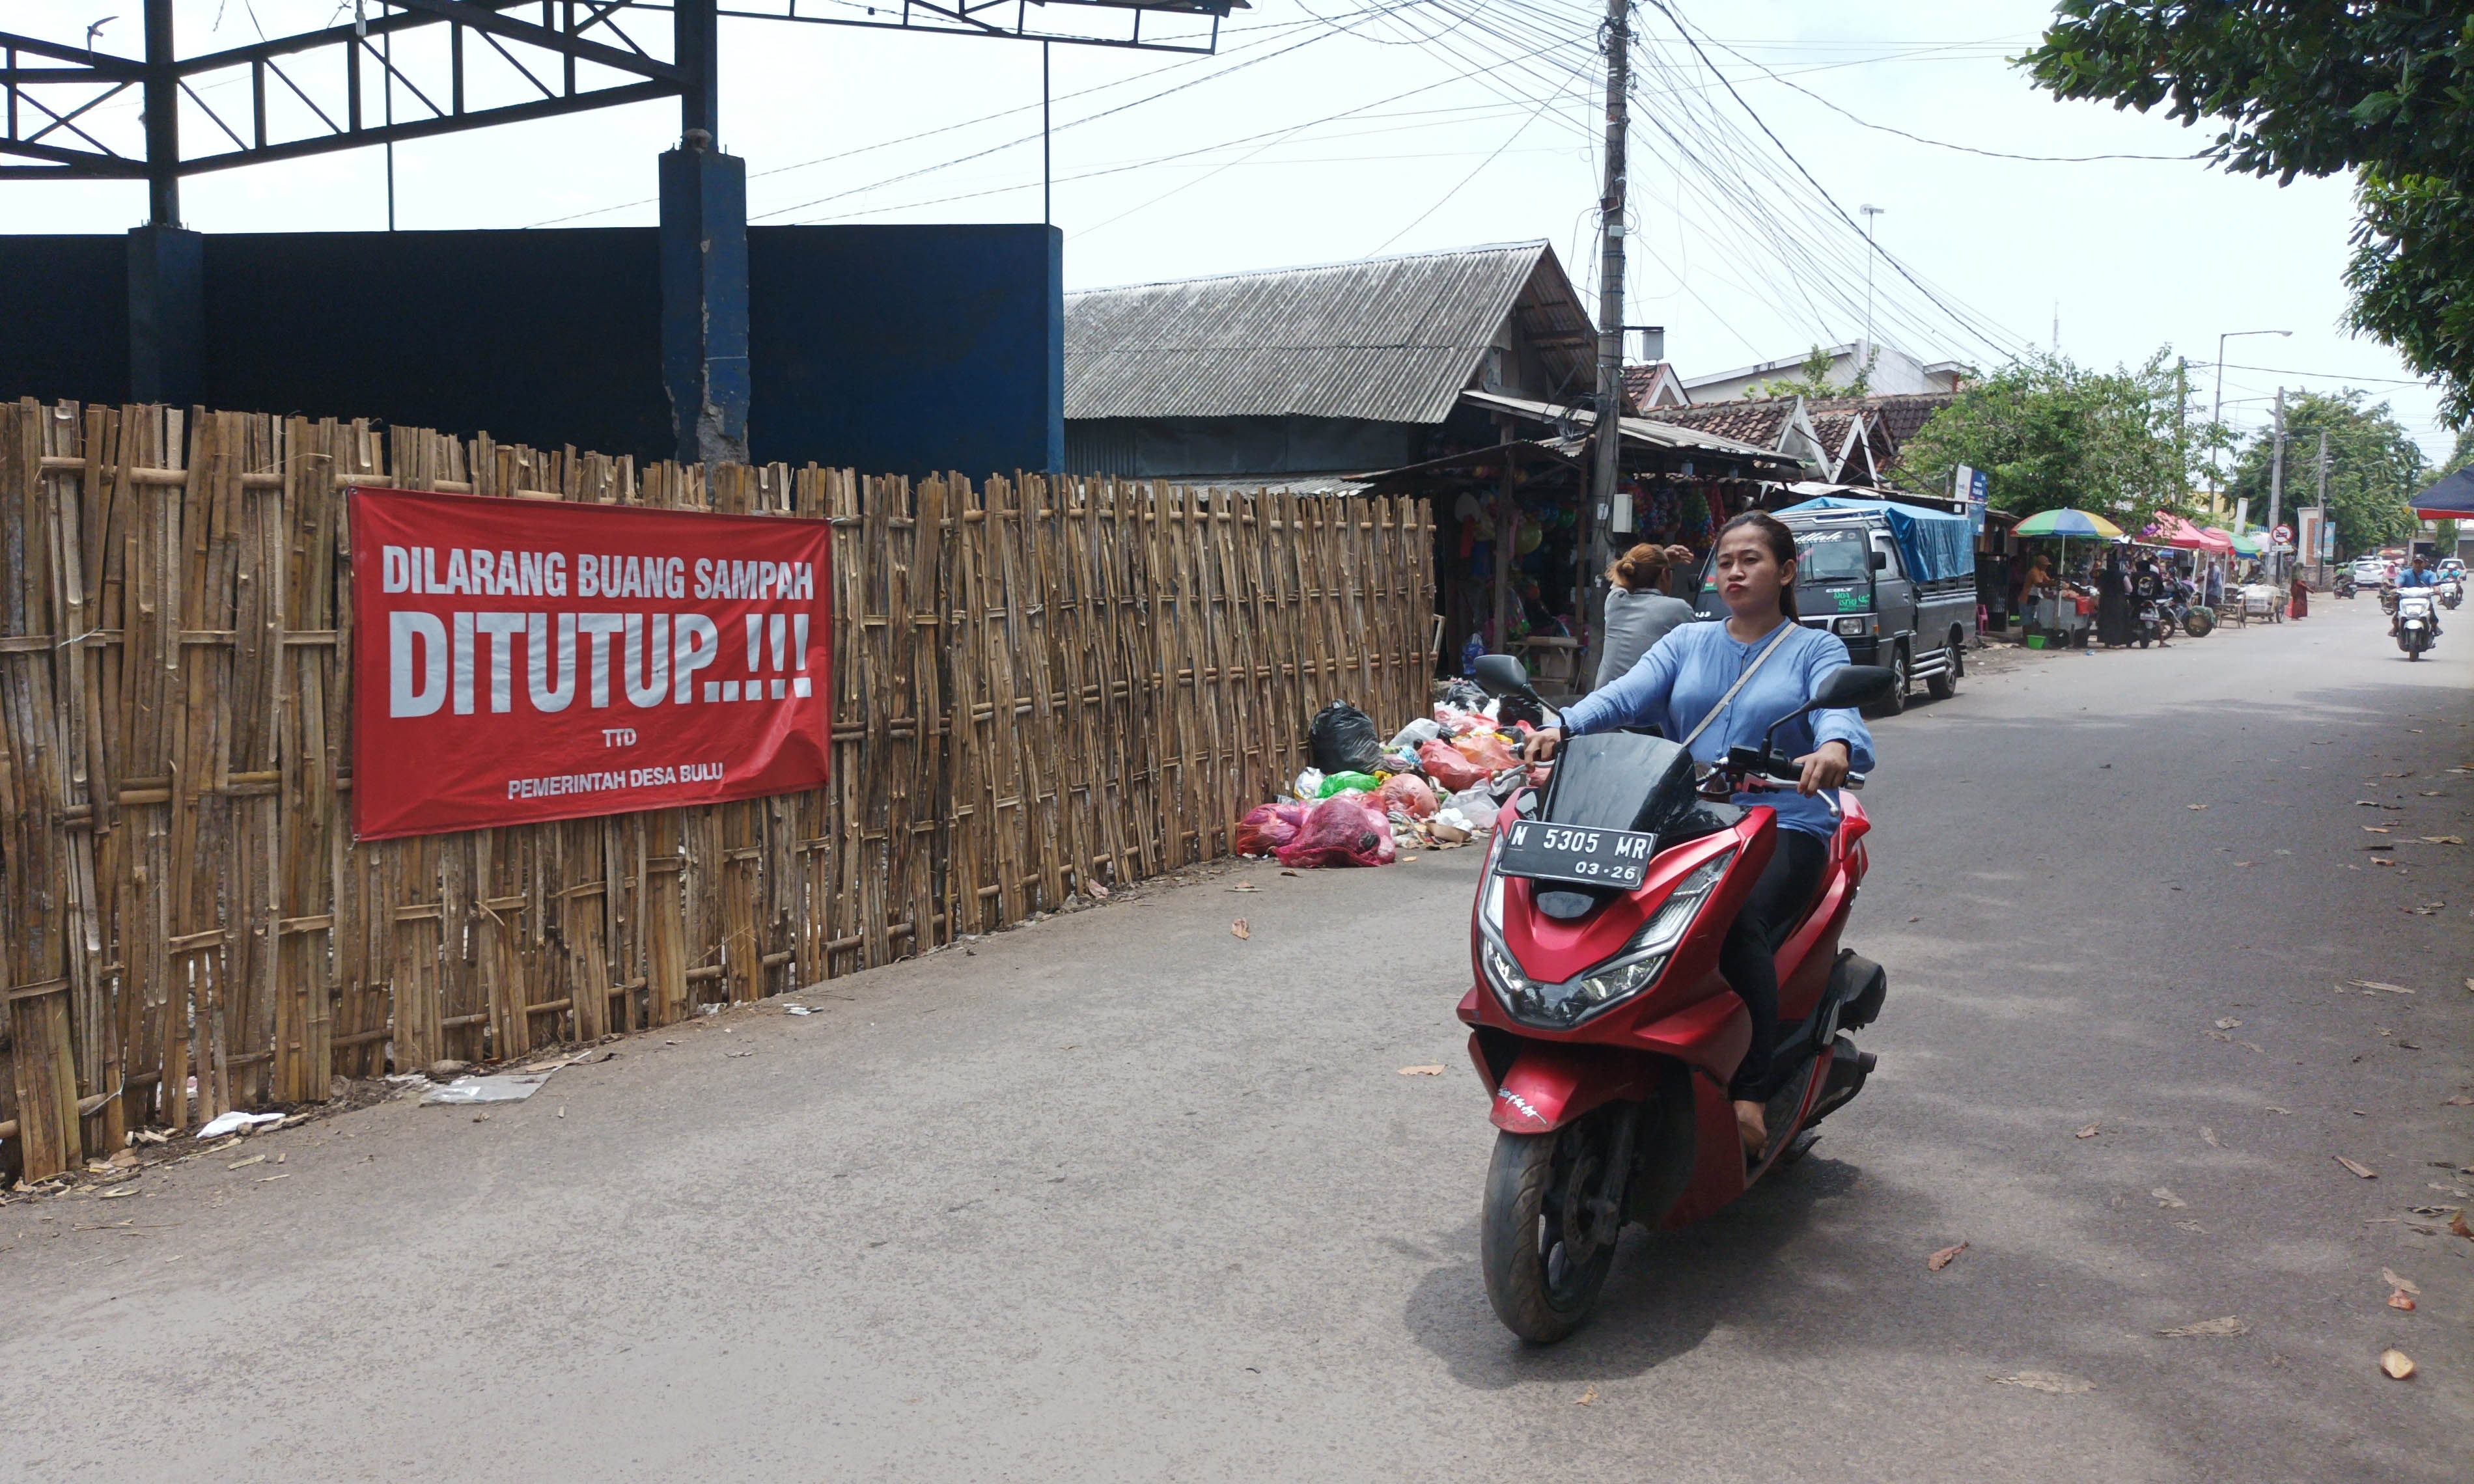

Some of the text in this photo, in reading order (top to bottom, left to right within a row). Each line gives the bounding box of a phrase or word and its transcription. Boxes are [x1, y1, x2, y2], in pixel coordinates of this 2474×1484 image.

[383, 545, 814, 600] DILARANG BUANG SAMPAH
[602, 728, 637, 748] TTD
[508, 762, 724, 800] PEMERINTAH DESA BULU
[1511, 825, 1648, 860] N 5305 MR
